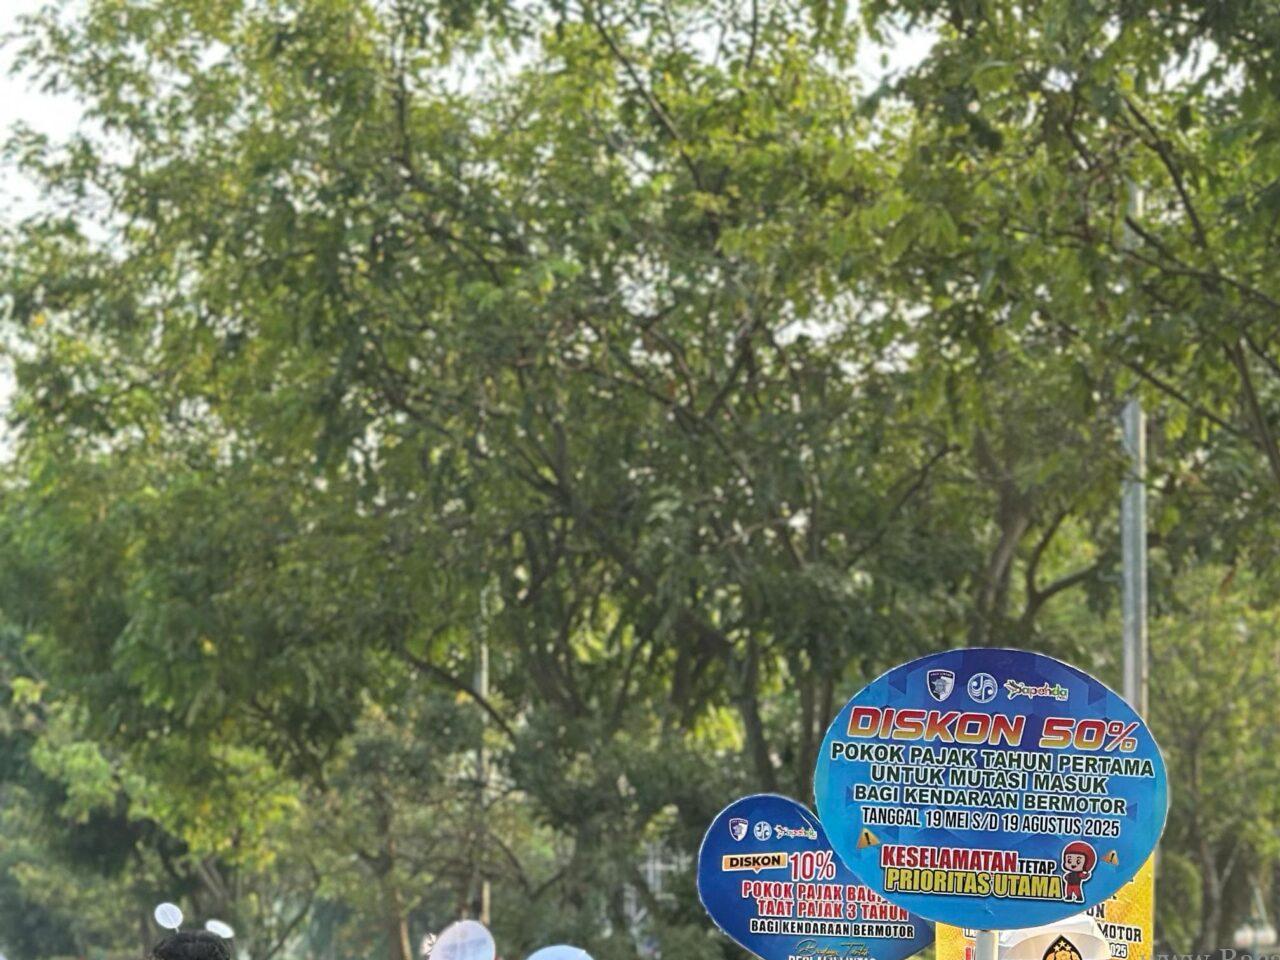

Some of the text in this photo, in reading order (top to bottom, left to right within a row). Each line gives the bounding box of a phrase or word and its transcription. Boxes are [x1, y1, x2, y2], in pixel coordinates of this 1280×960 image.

[847, 706, 1140, 752] DISKON 50%
[831, 742, 1155, 777] POKOK PAJAK TAHUN PERTAMA
[871, 764, 1109, 795] UNTUK MUTASI MASUK
[854, 784, 1127, 815] BAGI KENDARAAN BERMOTOR
[862, 806, 1121, 838] TANGGAL 19 MEI S/D 19 AGUSTUS 2025
[729, 851, 835, 881] DISKON 10%
[881, 844, 1056, 875] KESELAMATAN TETAP
[742, 881, 794, 899] POKOK
[797, 883, 843, 901] PAJAK
[885, 867, 1063, 899] PRIORITAS UTAMA
[757, 899, 909, 921] TAAT PAJAK 3 TAHUN
[751, 920, 914, 938] BAGI KENDARAAN BERMOTOR
[1097, 922, 1142, 943] MOTOR
